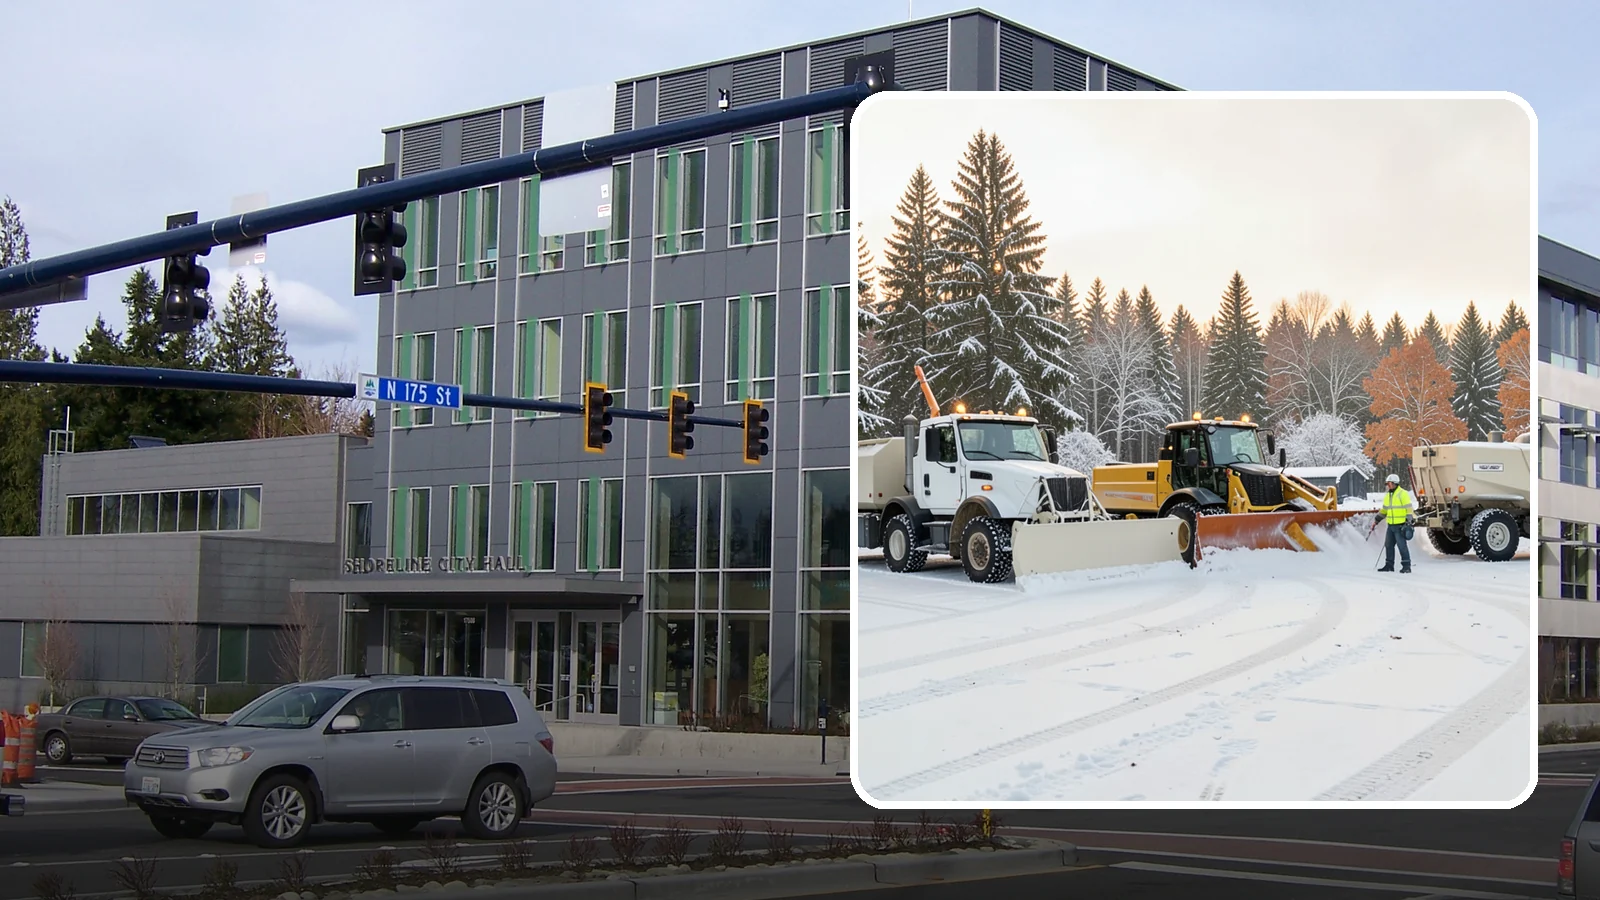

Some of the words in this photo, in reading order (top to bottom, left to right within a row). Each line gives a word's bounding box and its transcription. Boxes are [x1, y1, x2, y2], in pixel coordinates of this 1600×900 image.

[387, 380, 396, 400] N
[405, 383, 427, 403] 175
[436, 386, 451, 406] St
[344, 556, 432, 574] SHORELINE
[438, 556, 475, 572] CITY
[483, 555, 526, 572] HALL
